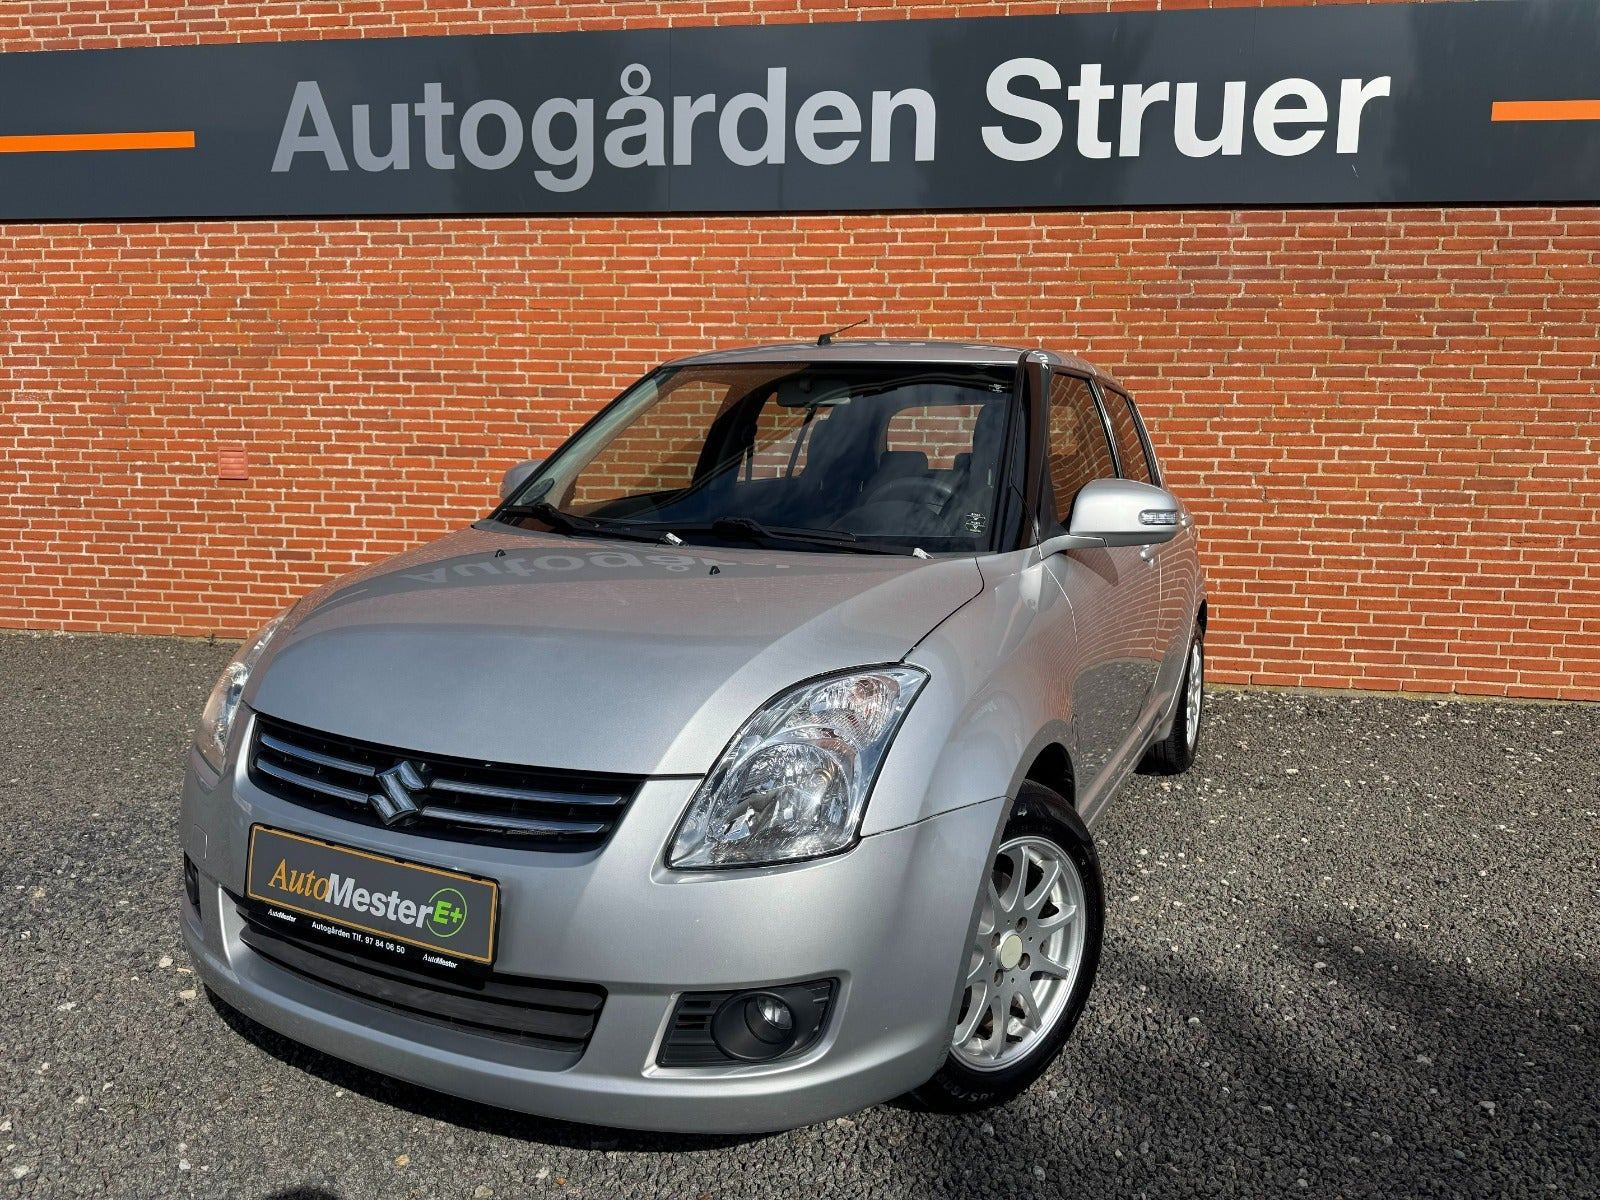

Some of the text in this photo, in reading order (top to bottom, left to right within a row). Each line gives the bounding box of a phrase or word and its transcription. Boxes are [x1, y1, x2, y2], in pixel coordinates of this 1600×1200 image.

[271, 58, 1391, 192] Autogården Struer
[268, 858, 463, 928] AutoMester E+
[311, 920, 406, 954] Autogården Tlf. 97 84 06 50
